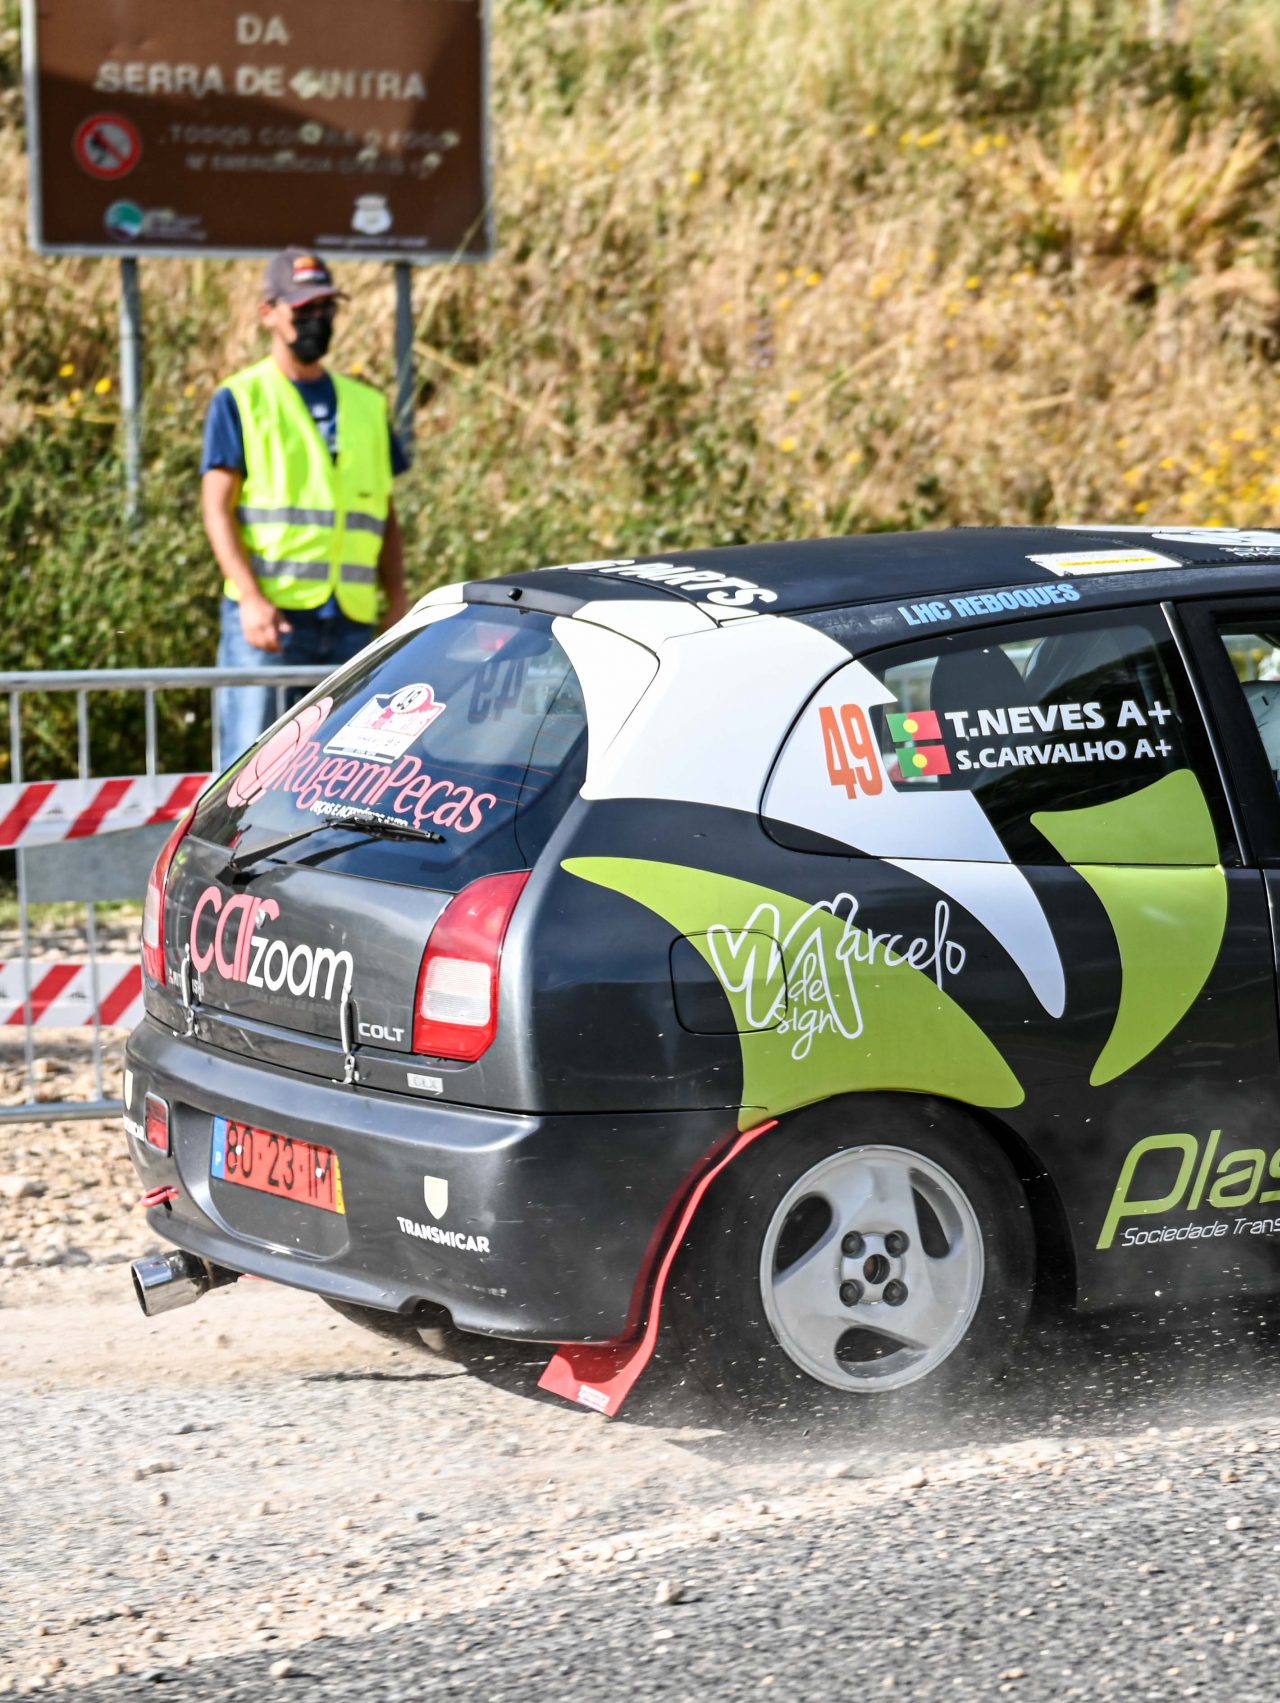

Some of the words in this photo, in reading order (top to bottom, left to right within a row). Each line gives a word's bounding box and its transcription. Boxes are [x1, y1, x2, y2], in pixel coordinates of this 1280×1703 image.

[236, 14, 290, 46] DA
[95, 62, 225, 97] SERRA
[236, 66, 284, 97] DE
[289, 68, 427, 100] INTRA
[598, 562, 779, 607] PARTS
[897, 601, 952, 626] LHC
[949, 583, 1081, 618] REBOQUES
[944, 701, 1105, 739] T.NEVES
[1116, 700, 1172, 728] A+
[818, 703, 884, 800] 49
[956, 740, 1129, 771] S.CARVALHO
[1133, 738, 1172, 760] A+
[357, 1022, 405, 1043] COLT
[396, 1216, 491, 1254] TRANSMICAR
[1121, 1219, 1229, 1247] Sociedade
